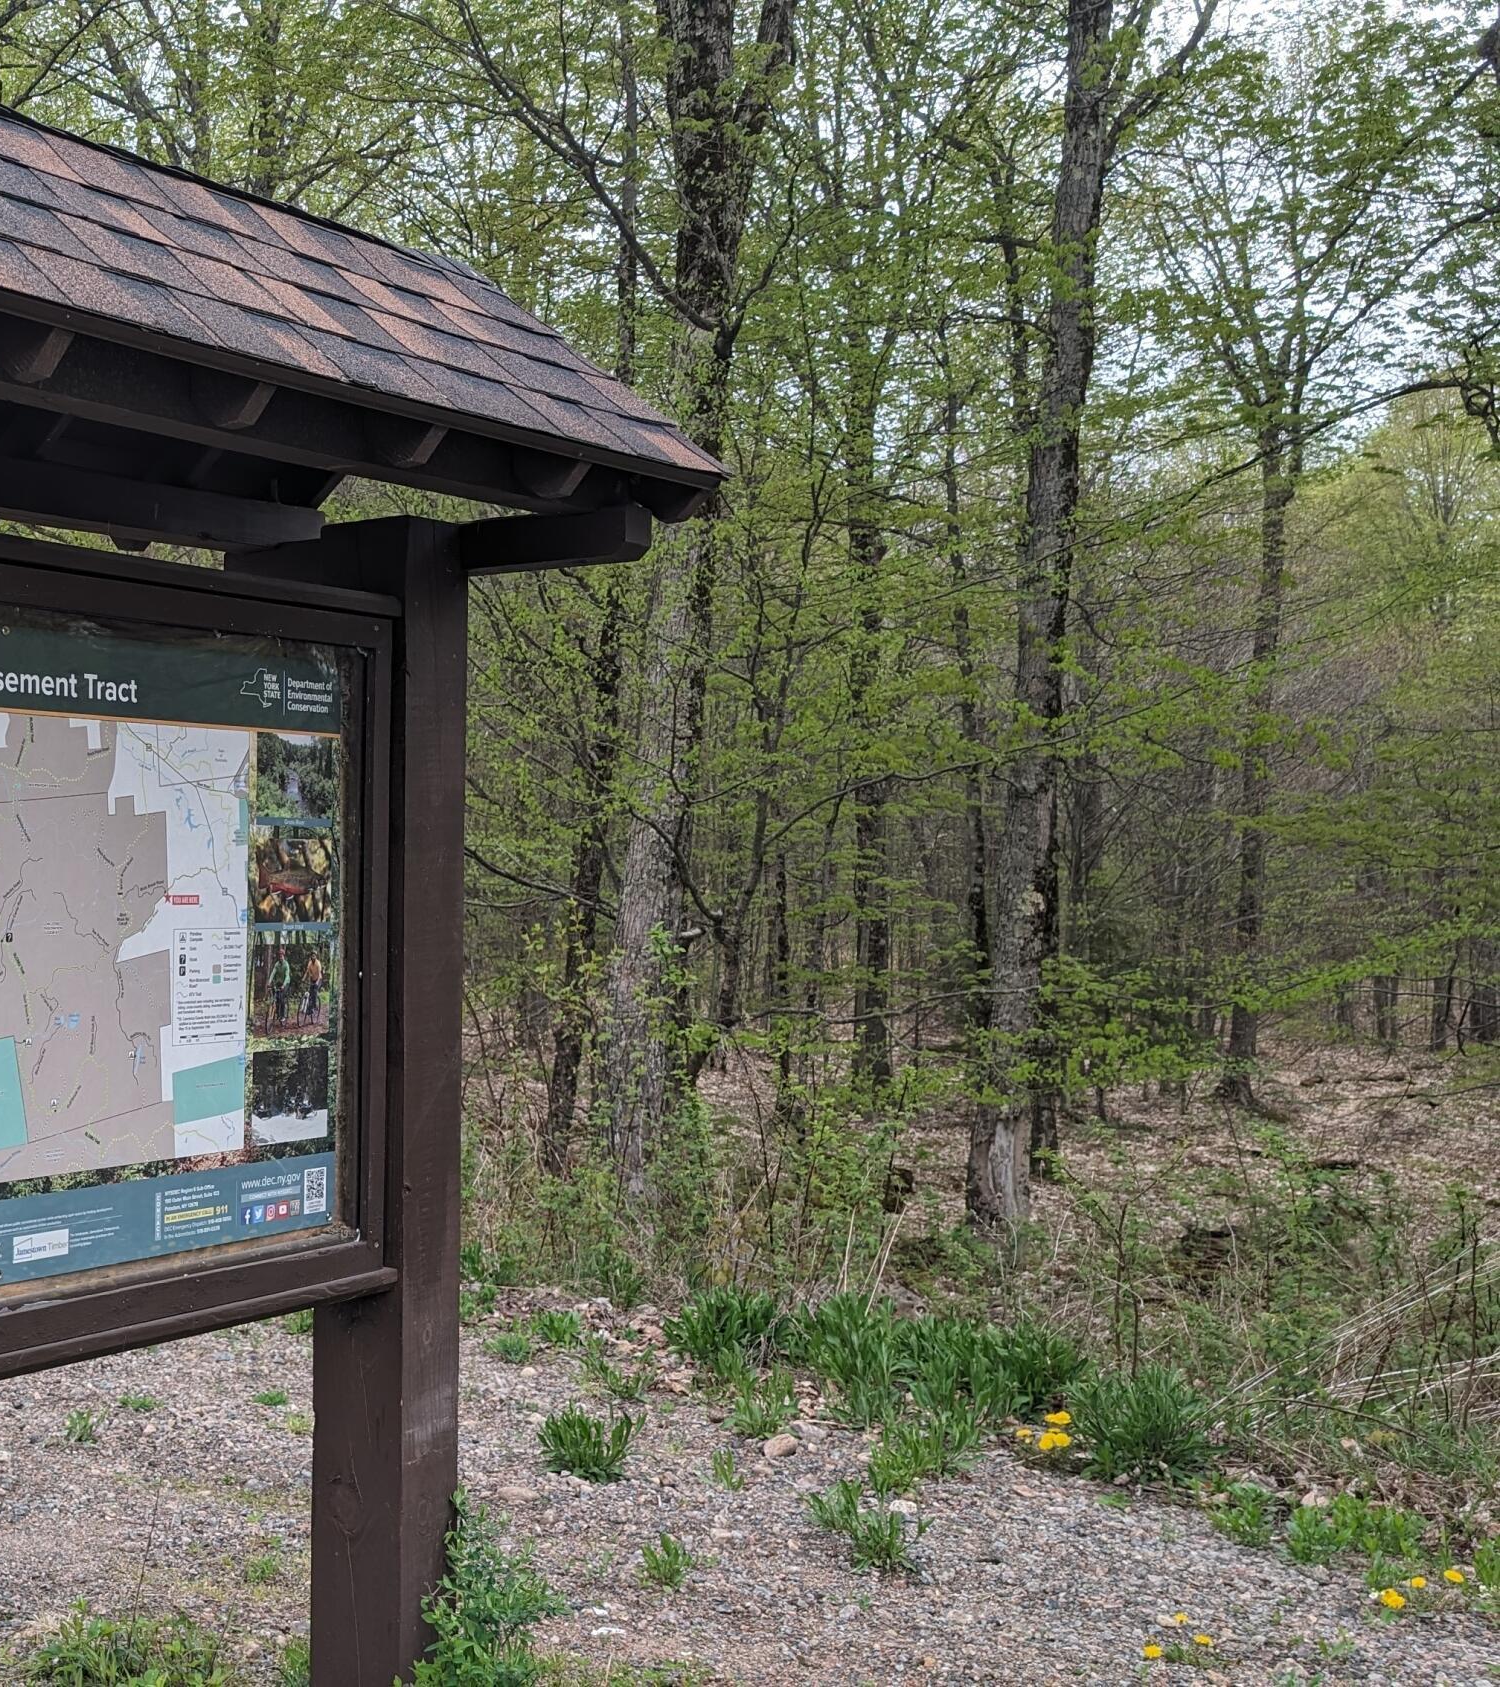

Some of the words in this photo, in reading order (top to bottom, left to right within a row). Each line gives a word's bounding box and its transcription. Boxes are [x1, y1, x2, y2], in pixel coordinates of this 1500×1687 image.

[264, 674, 277, 682] NEW
[288, 678, 325, 690] Department
[325, 682, 333, 690] of
[83, 673, 138, 703] Tract
[264, 682, 280, 690] YORK
[264, 691, 281, 699] STATE
[288, 691, 333, 703] Environmental
[287, 701, 329, 713] Conservation
[241, 1173, 301, 1190] www.dec.ny.gov
[215, 1205, 228, 1214] 911
[15, 1245, 47, 1256] Jamestown
[48, 1242, 68, 1252] Timber
